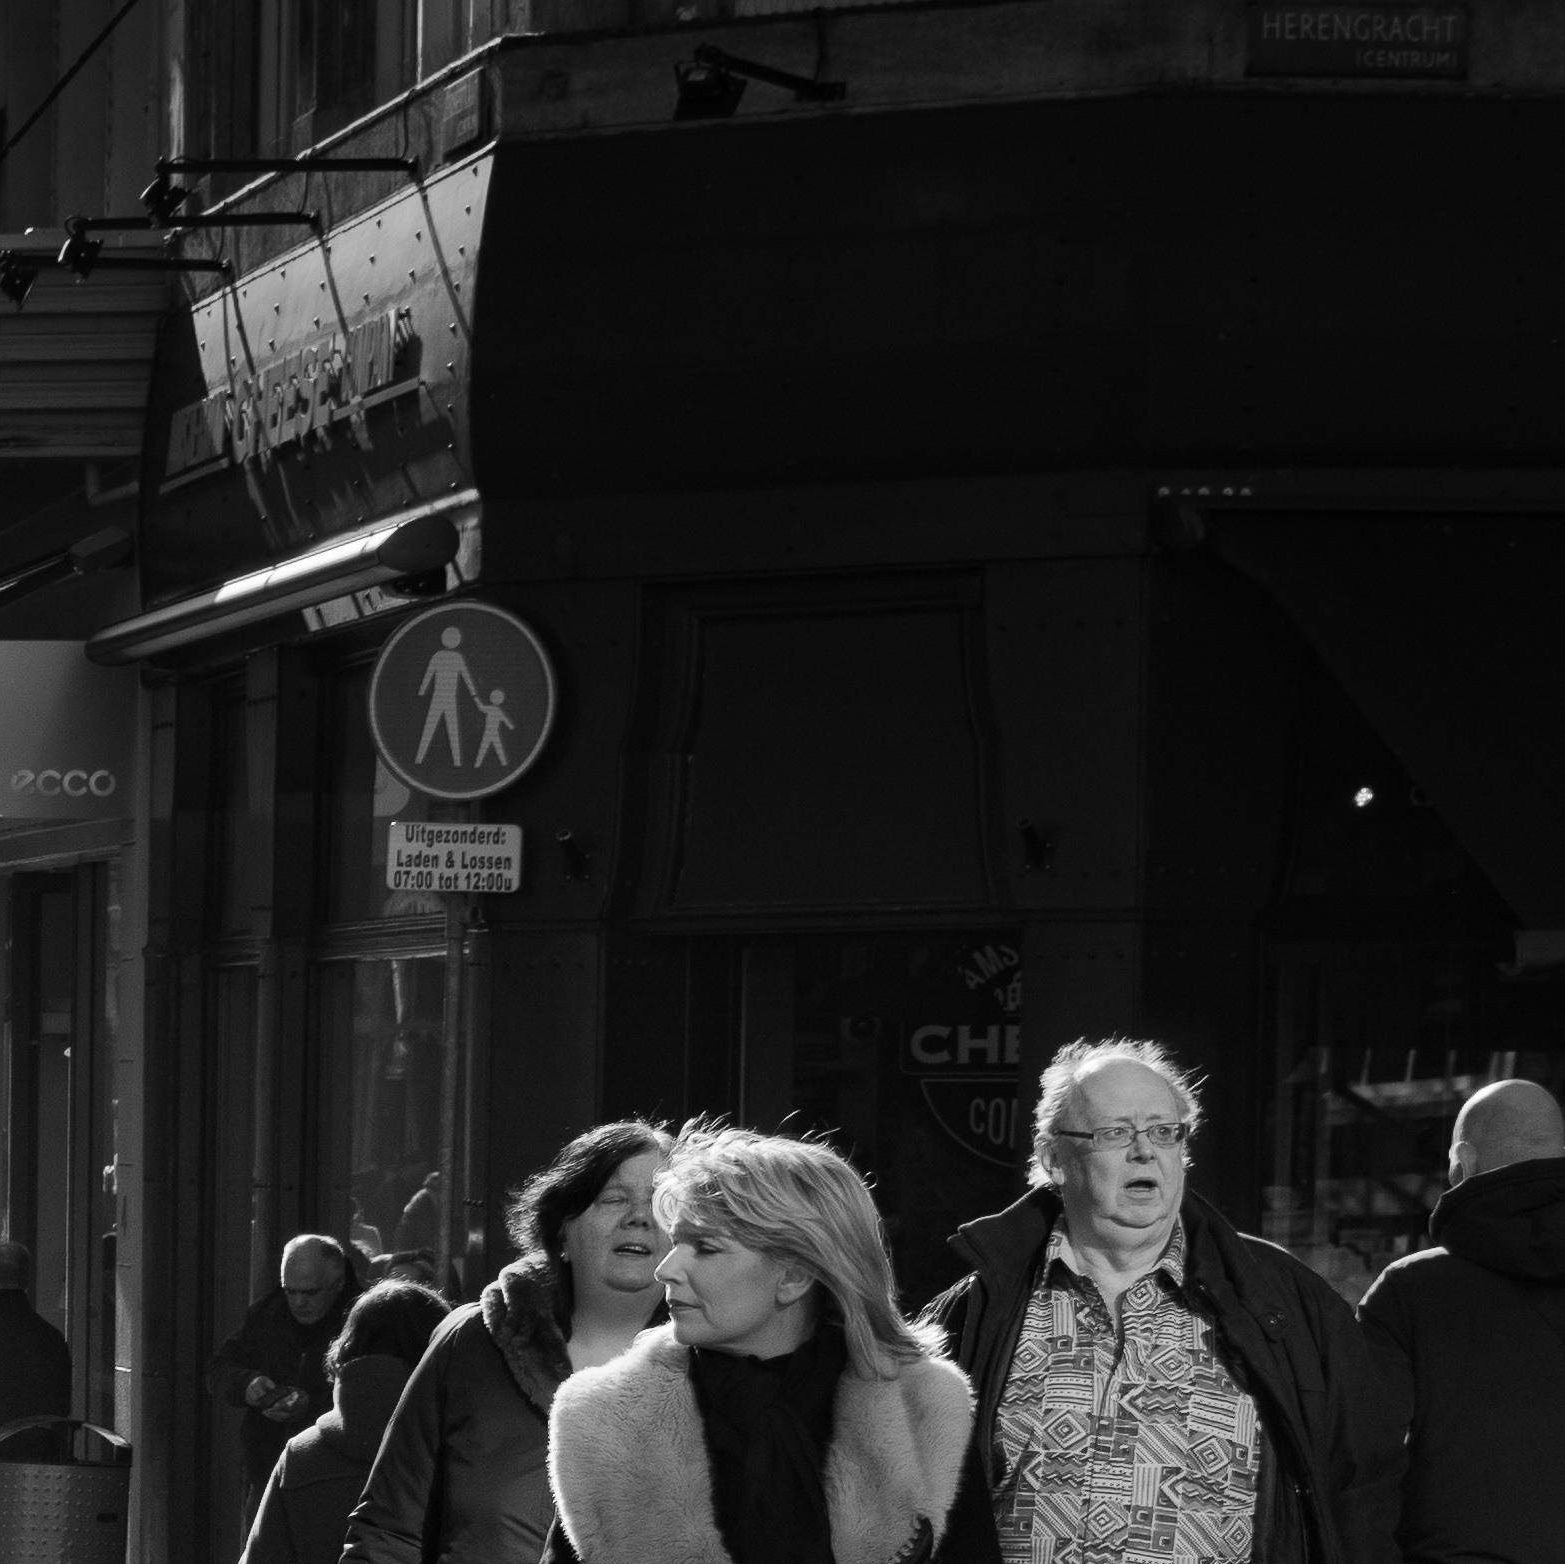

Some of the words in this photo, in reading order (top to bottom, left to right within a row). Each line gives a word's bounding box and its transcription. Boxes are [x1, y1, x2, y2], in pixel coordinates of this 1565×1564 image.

[1262, 12, 1458, 42] HERENGRACHT
[10, 769, 116, 797] ecco
[406, 825, 506, 847] Uitgezonderd:
[397, 850, 439, 868] Laden
[445, 850, 454, 868] &
[461, 851, 511, 869] Lossen
[394, 870, 433, 888] 07:00
[438, 873, 459, 889] tot
[465, 873, 512, 890] 12:00u
